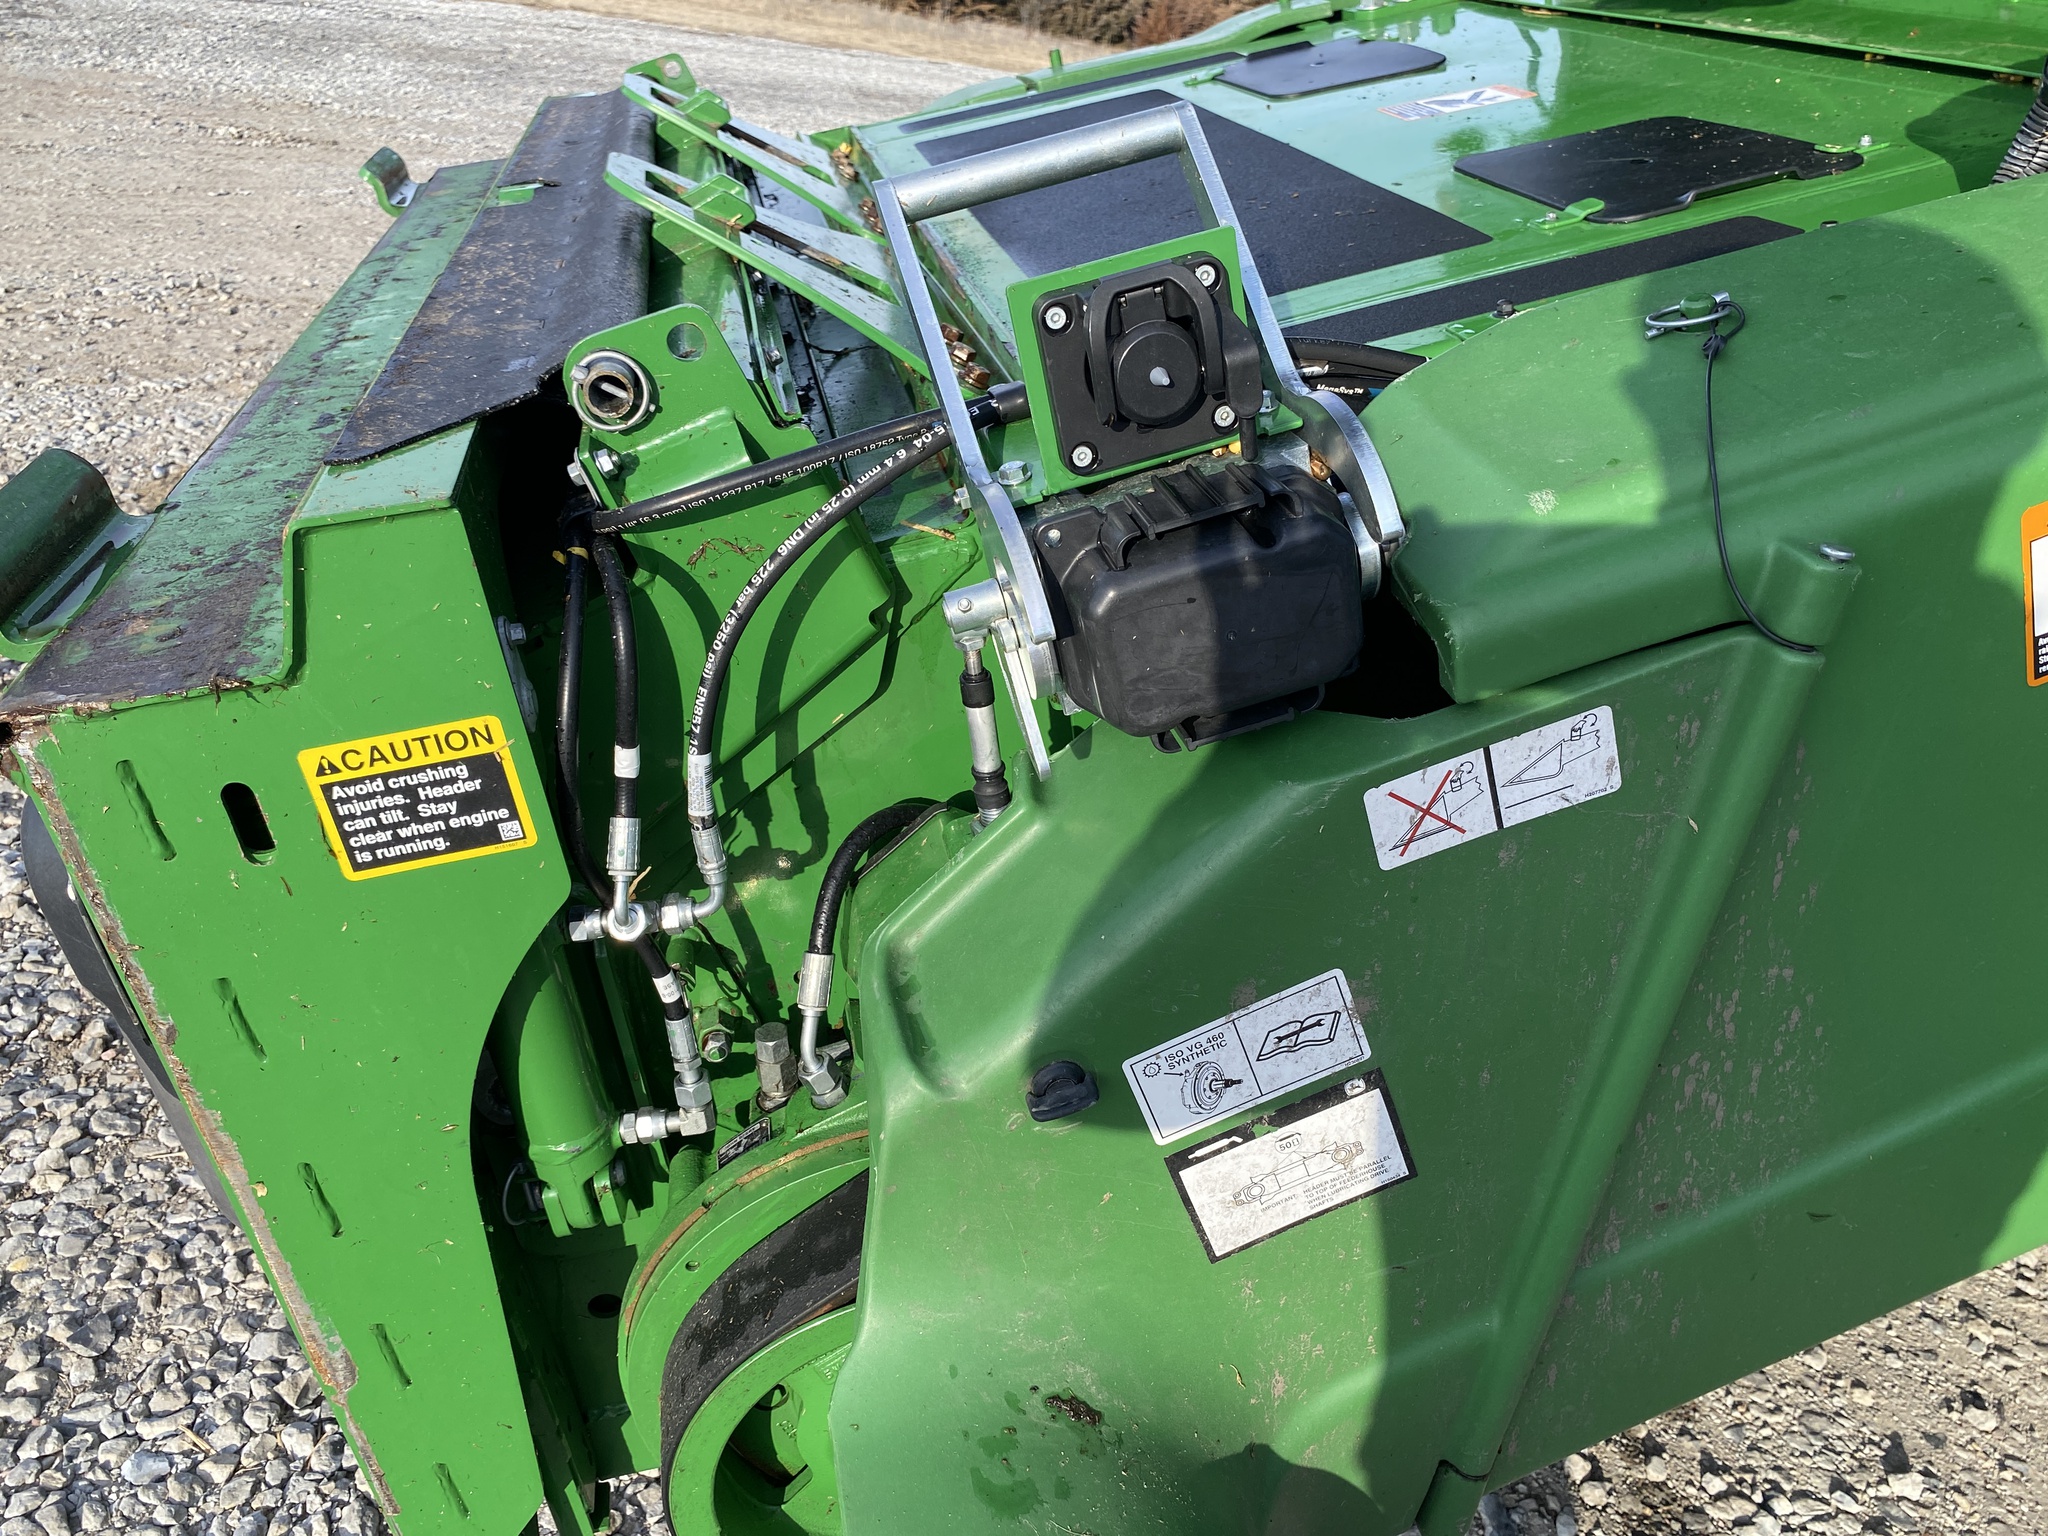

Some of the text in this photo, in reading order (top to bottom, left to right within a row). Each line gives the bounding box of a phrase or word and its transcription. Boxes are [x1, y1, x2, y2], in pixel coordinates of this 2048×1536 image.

[883, 448, 907, 467] 6.4
[857, 465, 881, 485] mm
[821, 484, 857, 514] (0.25
[804, 513, 822, 530] in)
[777, 528, 805, 557] DN6
[751, 558, 774, 587] 225
[735, 585, 754, 608] bar
[711, 609, 739, 651] (3250
[702, 652, 715, 678] psi)
[341, 725, 495, 771] CAUTION
[331, 764, 469, 800] Avoid crushing
[336, 777, 483, 817] injuries. Header
[343, 800, 458, 832] can tilt. Stay
[349, 807, 510, 848] clear when engine
[354, 838, 451, 864] is running.
[1164, 1031, 1225, 1063] ISO VG 460
[1167, 1039, 1228, 1070] SYNTHETIC
[1279, 1140, 1293, 1151] 50
[1303, 1180, 1330, 1194] HEADER
[1330, 1172, 1348, 1183] MUST
[1350, 1168, 1358, 1176] BE
[1359, 1155, 1392, 1170] PARALLEL
[1306, 1168, 1390, 1205] WHEN LUBRICATING DRIVE
[1315, 1187, 1328, 1195] TOP
[1339, 1163, 1386, 1185] FEEDERHOUSE
[1309, 1197, 1334, 1210] SHAFTS
